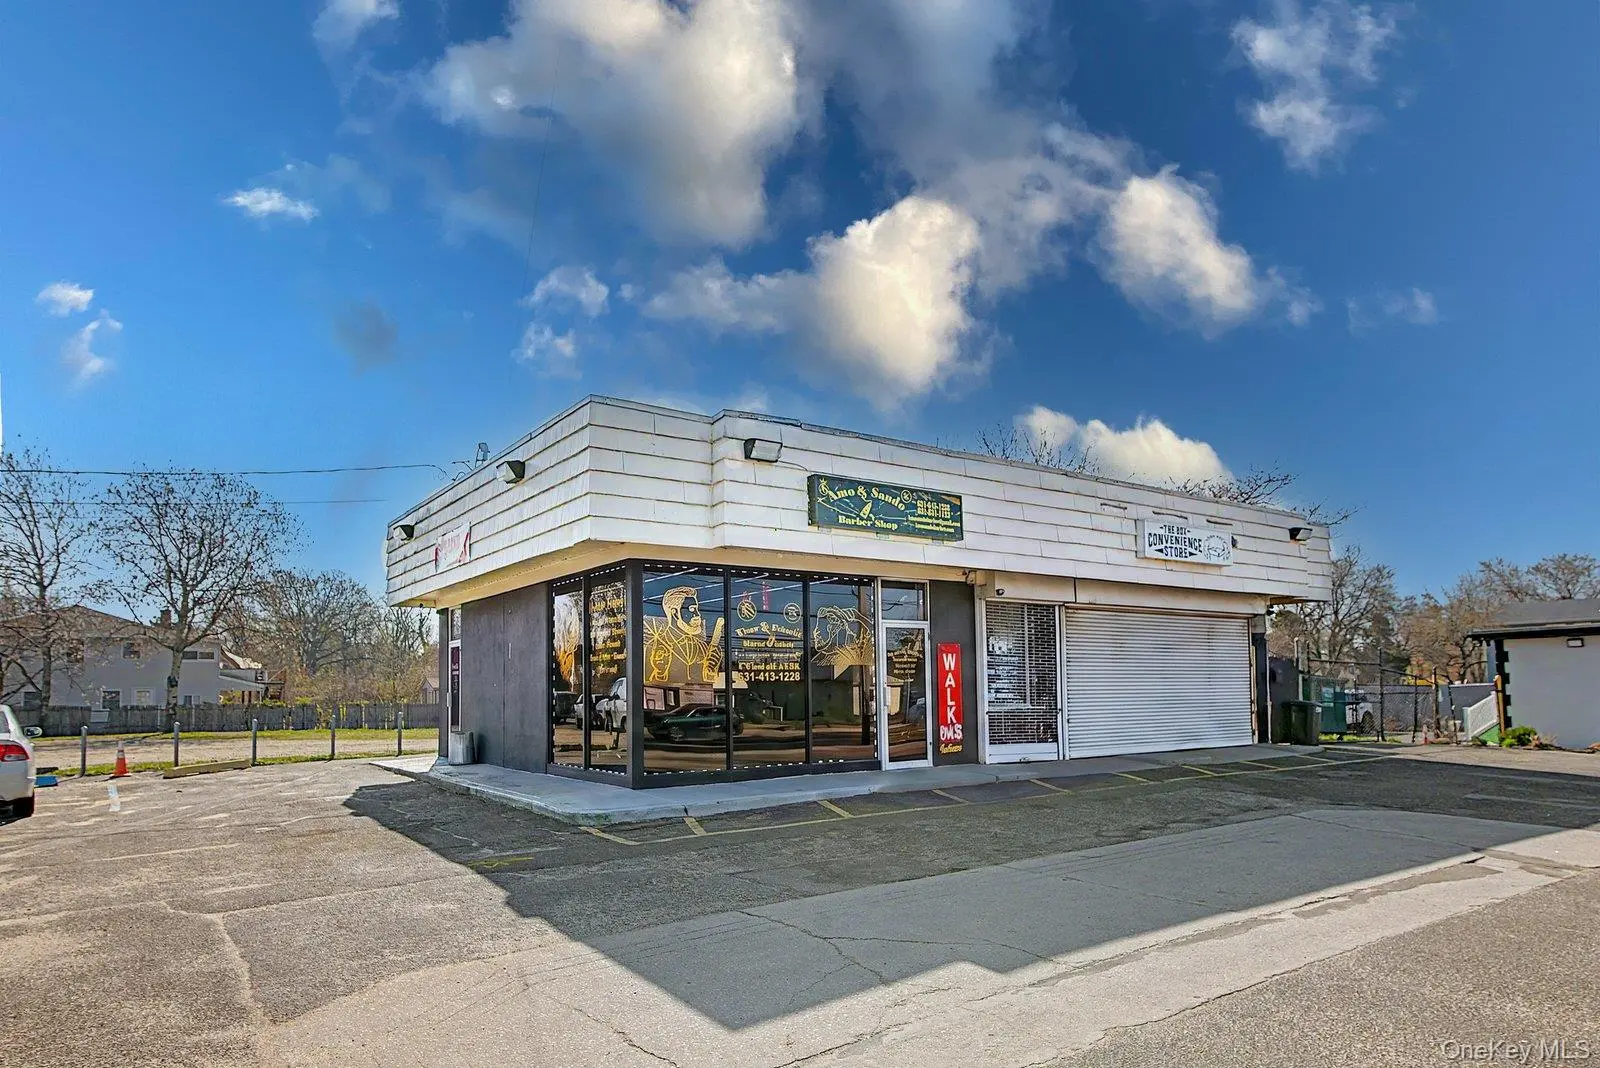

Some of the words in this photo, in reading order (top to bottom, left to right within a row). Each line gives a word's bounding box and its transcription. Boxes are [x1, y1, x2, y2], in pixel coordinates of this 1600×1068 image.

[857, 485, 868, 500] &
[838, 515, 873, 527] Barber
[875, 519, 898, 531] Shop
[1163, 524, 1175, 535] THE
[1176, 526, 1187, 536] BOX
[1148, 532, 1203, 553] CONVENIENCE
[1164, 545, 1188, 558] STORE
[942, 653, 957, 724] WALK
